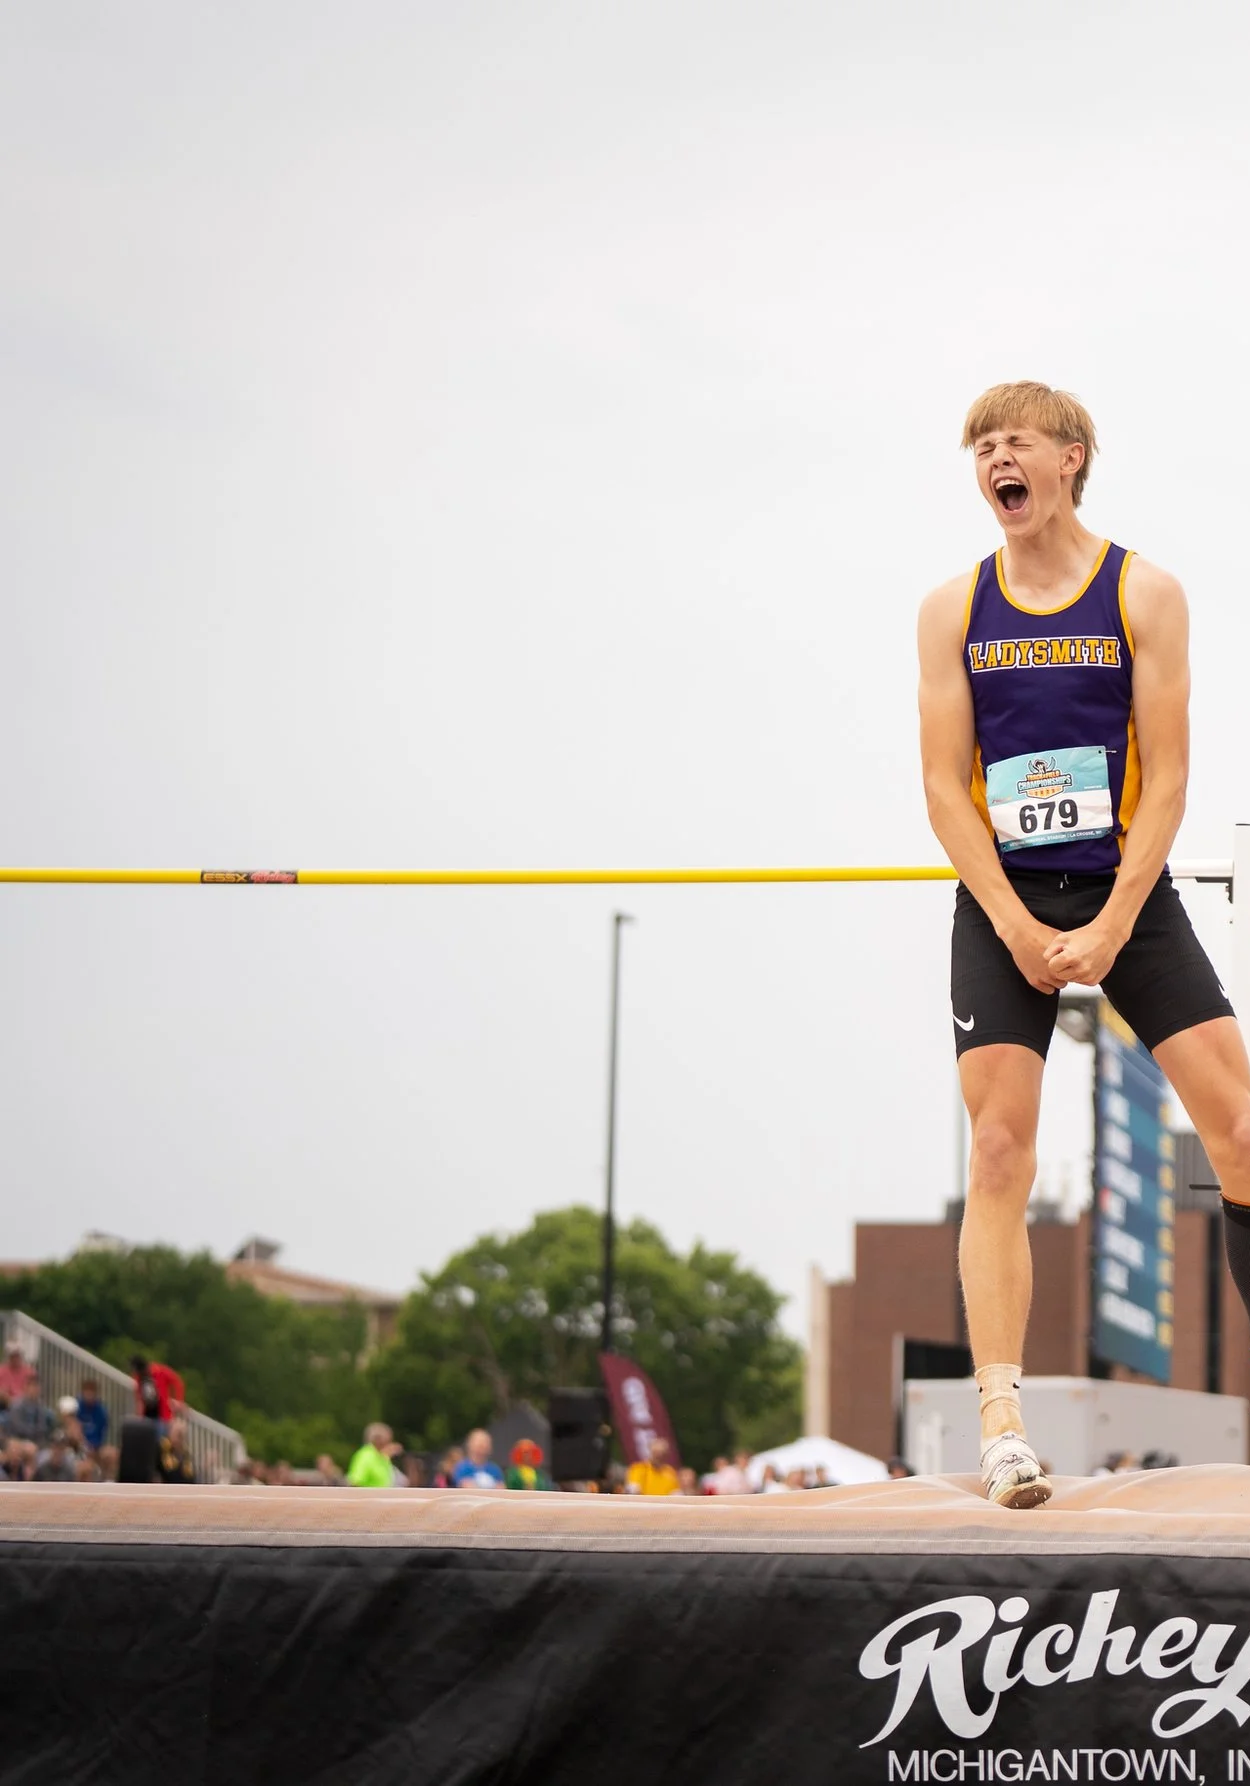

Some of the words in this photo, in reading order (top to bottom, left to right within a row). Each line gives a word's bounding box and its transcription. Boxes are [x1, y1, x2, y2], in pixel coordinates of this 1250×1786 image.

[969, 636, 1121, 673] LADYSMITH
[1019, 799, 1078, 834] 679
[888, 1749, 1206, 1786] MICHIGANTOWN,
